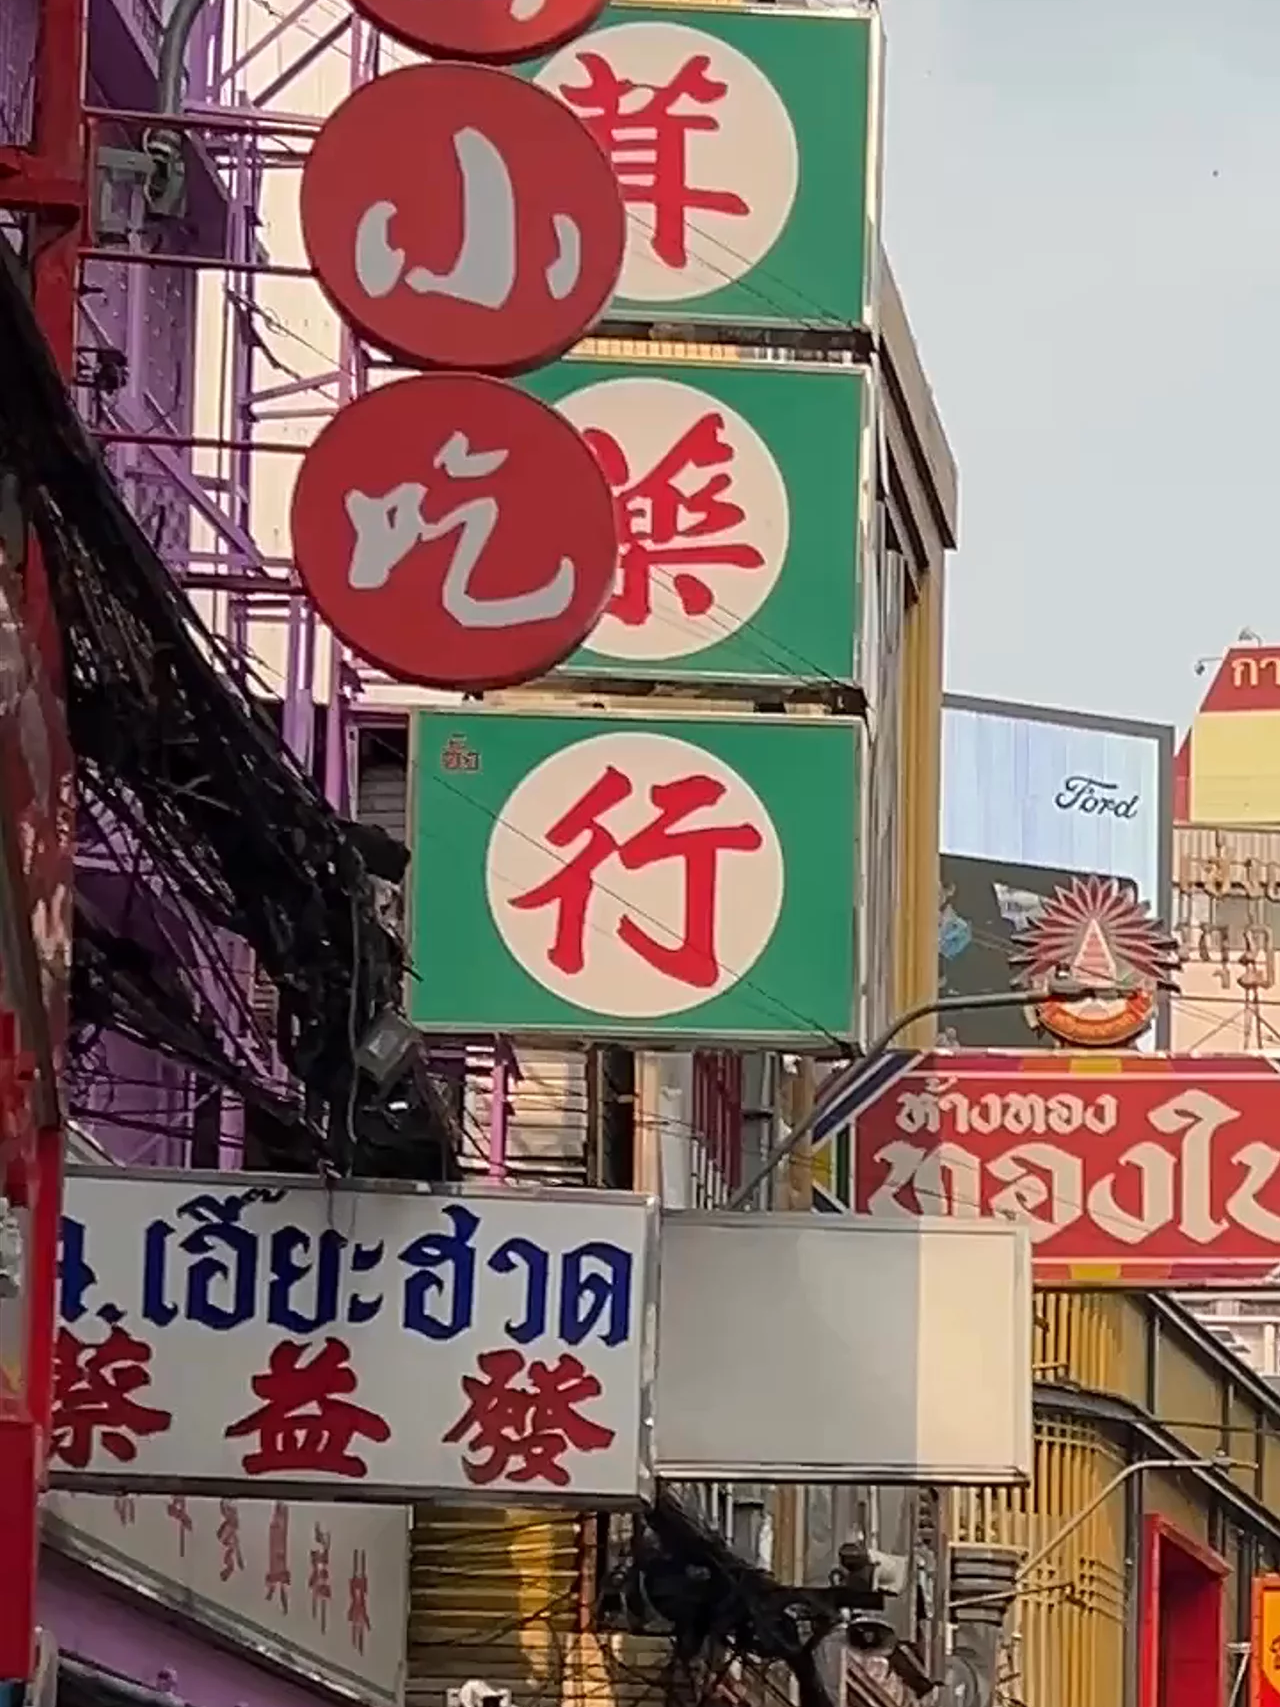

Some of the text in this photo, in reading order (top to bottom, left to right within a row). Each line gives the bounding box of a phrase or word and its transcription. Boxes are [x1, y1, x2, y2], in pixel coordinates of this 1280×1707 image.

[1054, 775, 1139, 820] Ford
[895, 1075, 1118, 1137] ห้างทอง
